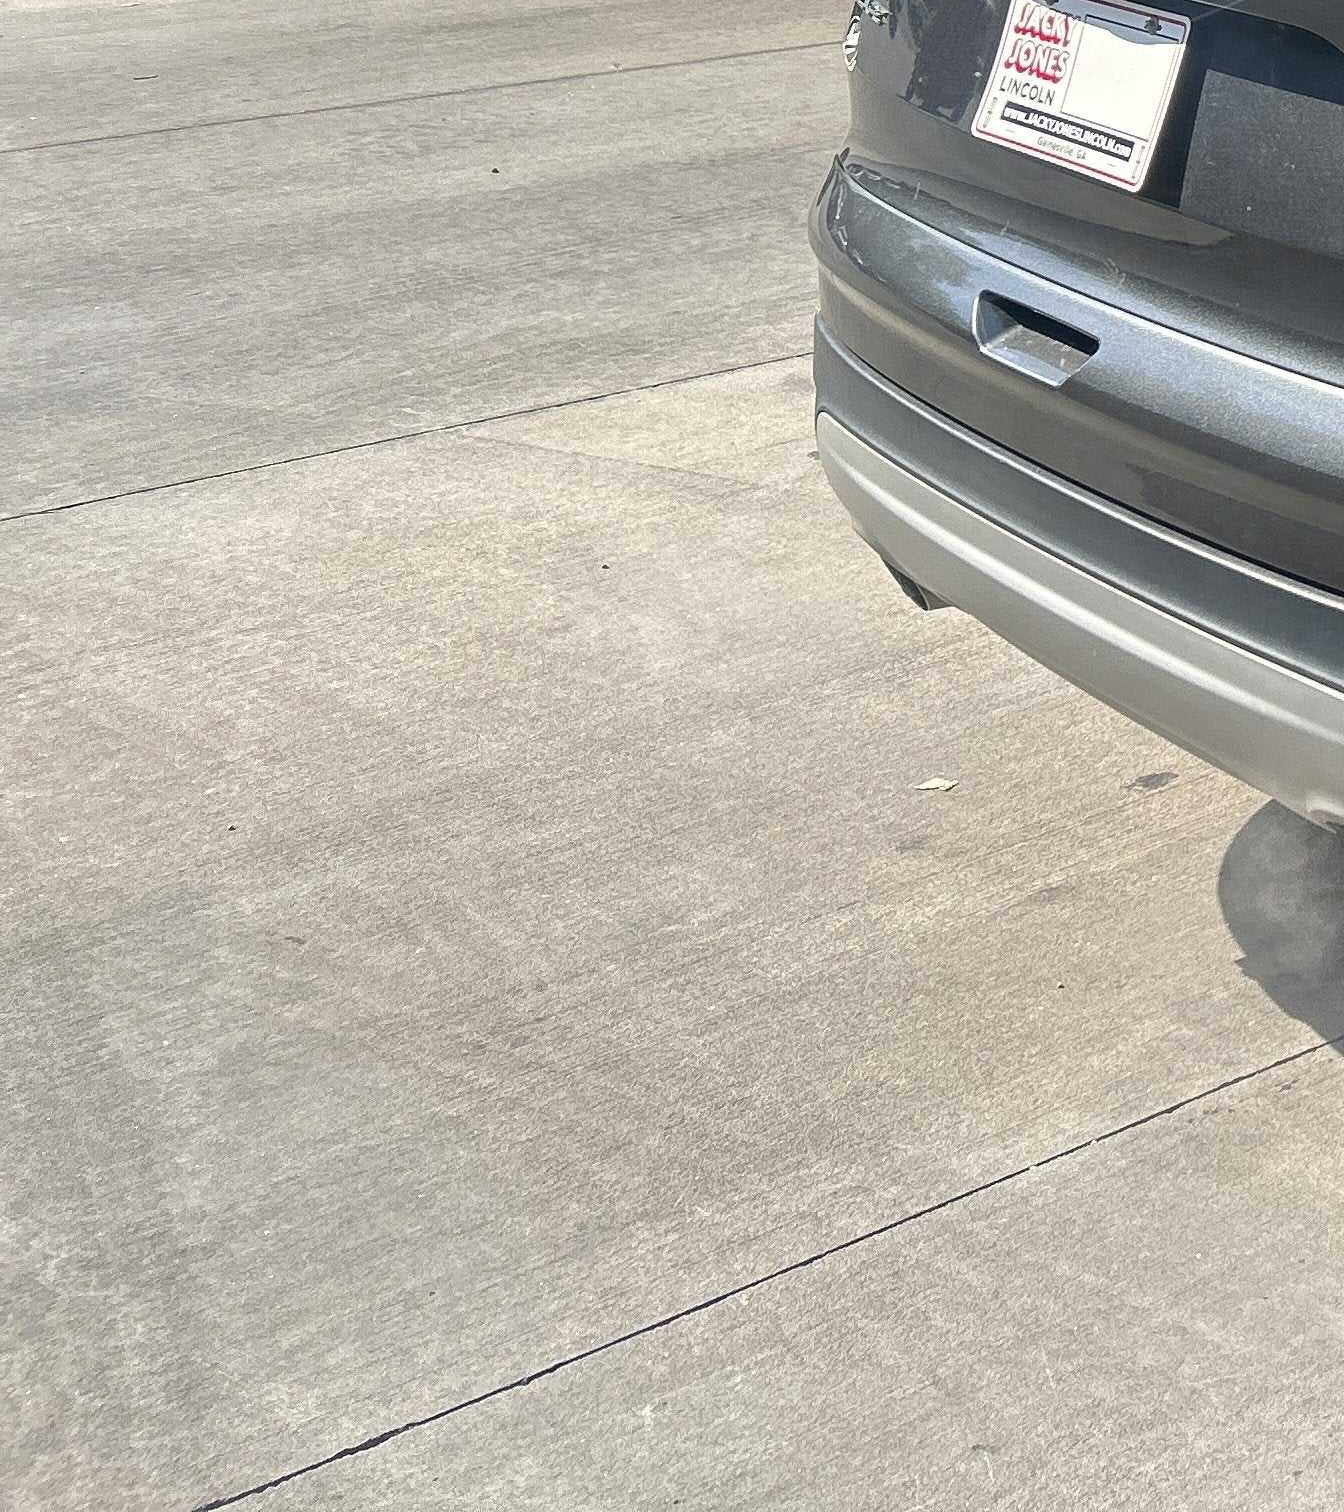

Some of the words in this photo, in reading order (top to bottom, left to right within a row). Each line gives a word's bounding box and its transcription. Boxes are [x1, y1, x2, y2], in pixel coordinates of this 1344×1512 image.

[1014, 2, 1079, 48] JACKY
[1004, 38, 1070, 84] JONES
[999, 76, 1055, 106] LINCOLN
